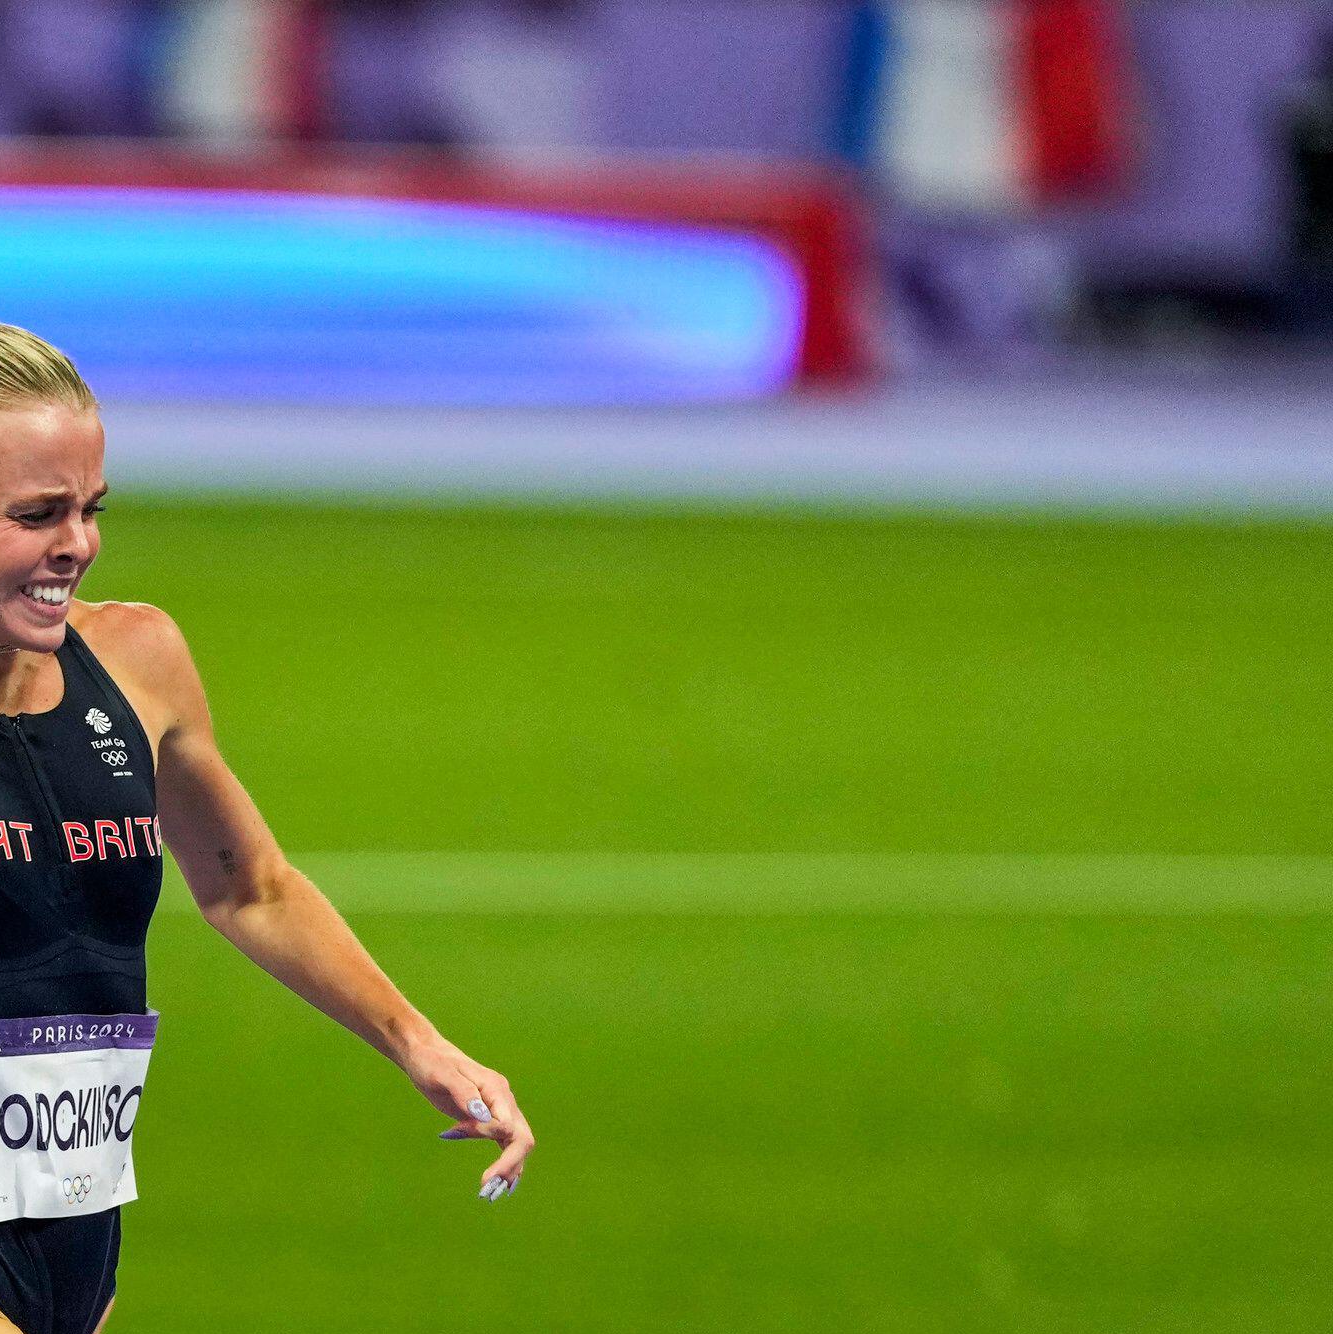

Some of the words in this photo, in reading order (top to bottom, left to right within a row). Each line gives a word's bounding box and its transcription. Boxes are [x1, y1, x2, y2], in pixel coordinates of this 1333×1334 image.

[90, 738, 113, 749] TEAM
[113, 737, 126, 748] GB
[88, 1023, 135, 1039] 2024
